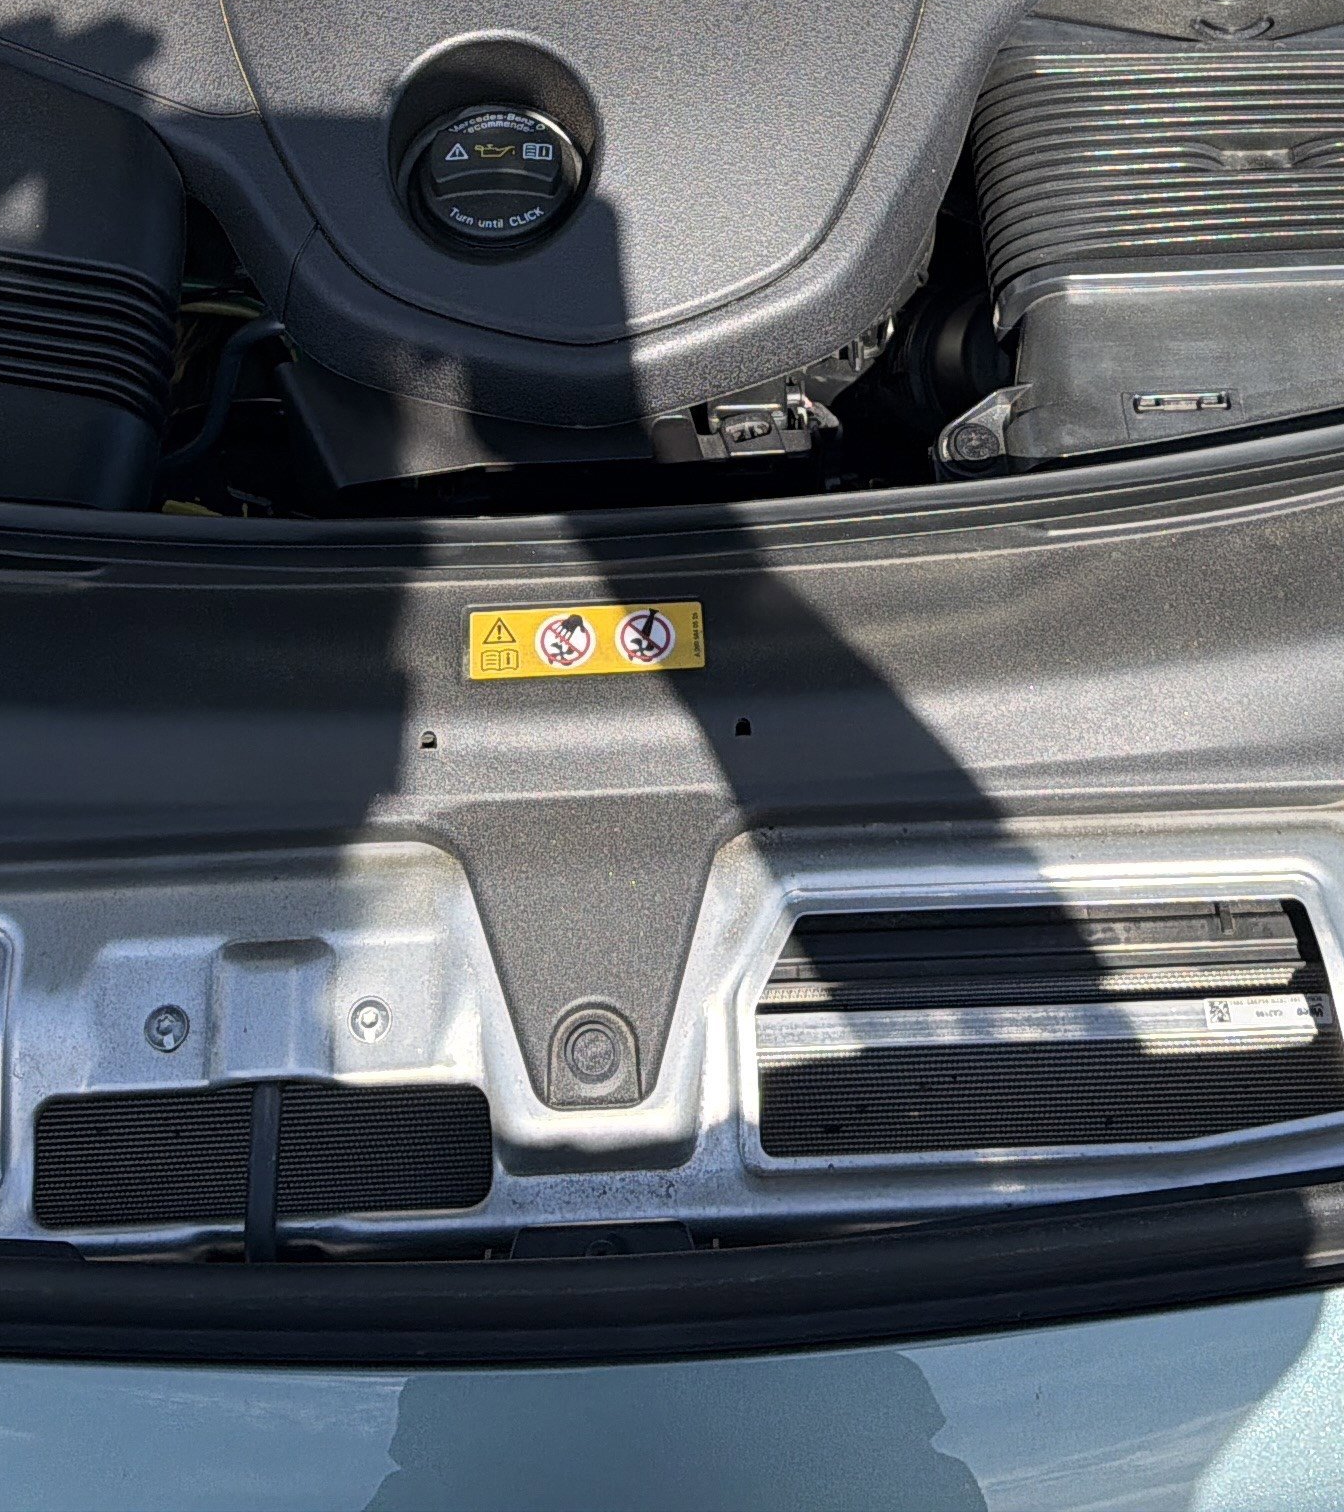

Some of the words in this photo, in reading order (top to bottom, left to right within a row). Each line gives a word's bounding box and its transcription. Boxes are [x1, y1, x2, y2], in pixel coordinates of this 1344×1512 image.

[449, 207, 474, 226] Turn
[478, 218, 504, 229] until
[509, 206, 545, 227] CLICK
